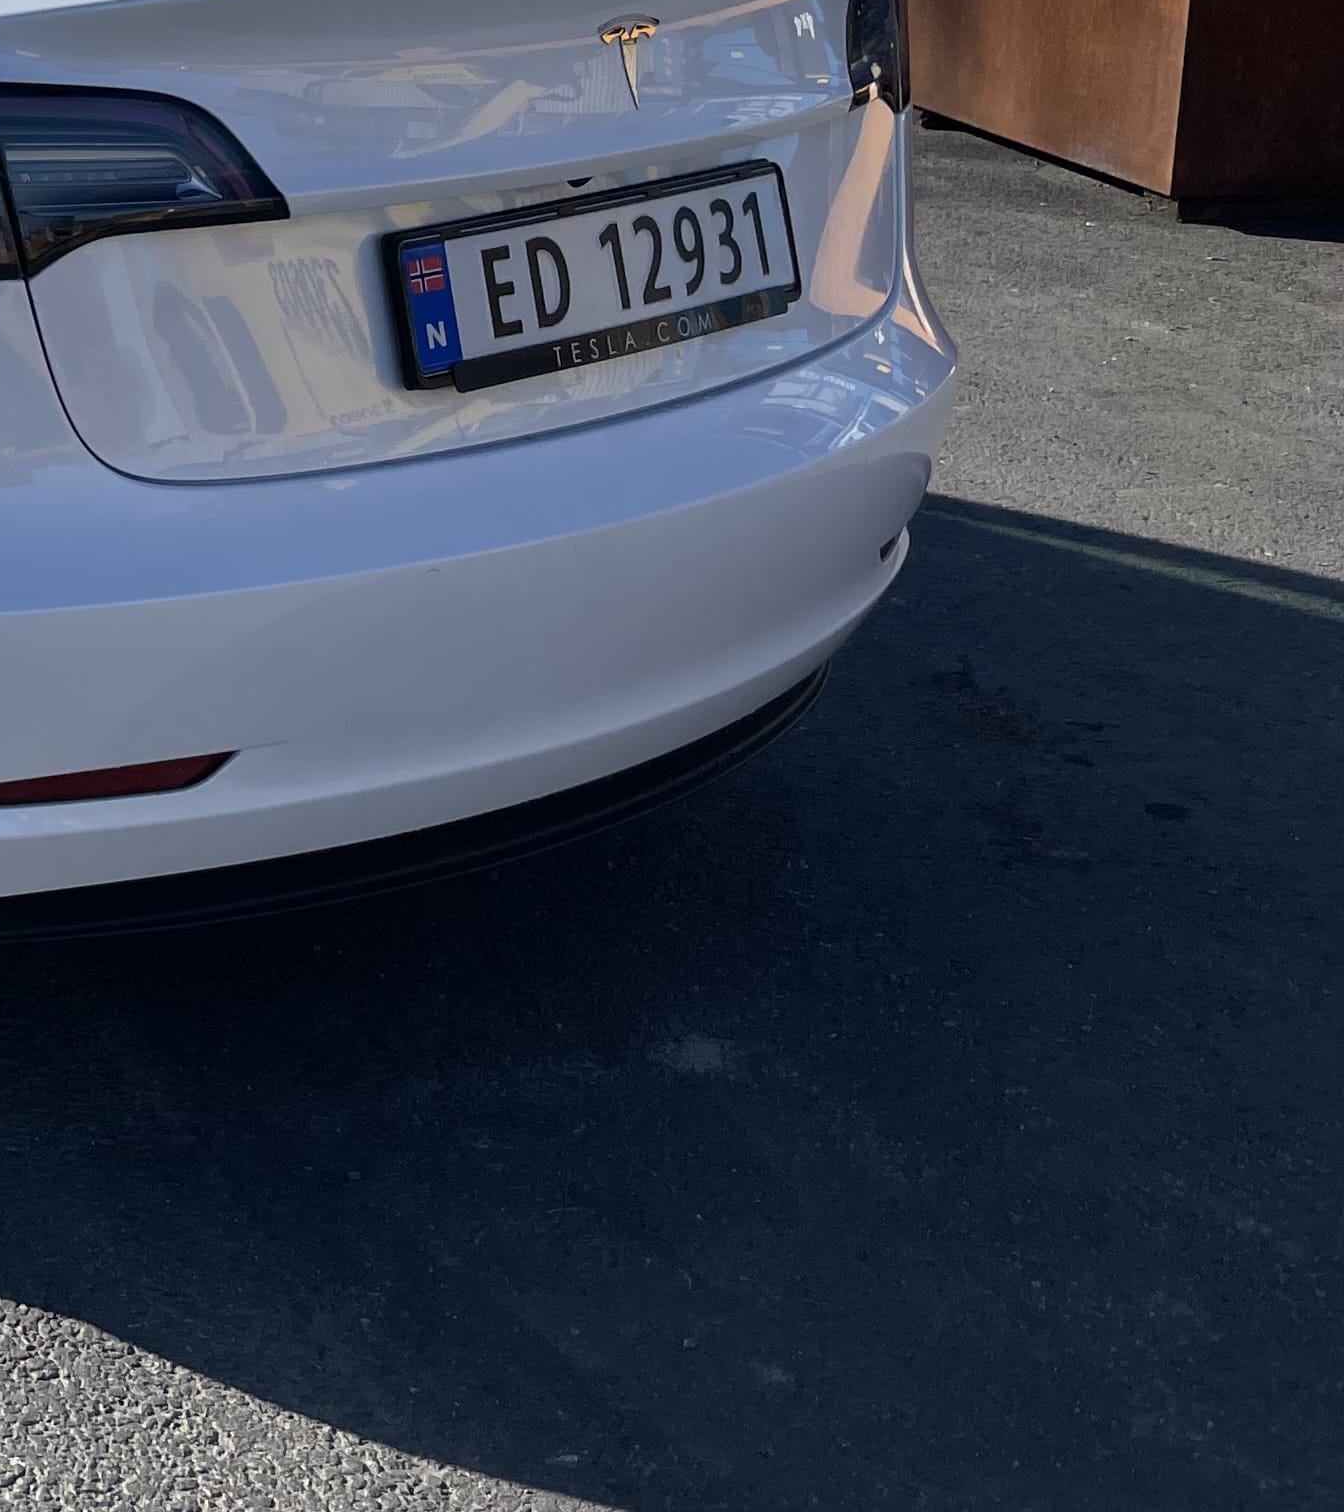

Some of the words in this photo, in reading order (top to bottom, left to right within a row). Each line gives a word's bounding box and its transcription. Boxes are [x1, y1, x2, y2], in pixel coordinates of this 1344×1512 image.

[480, 236, 571, 339] ED
[598, 191, 770, 311] 12931
[425, 321, 447, 350] N
[553, 311, 713, 368] TESLA.COM
